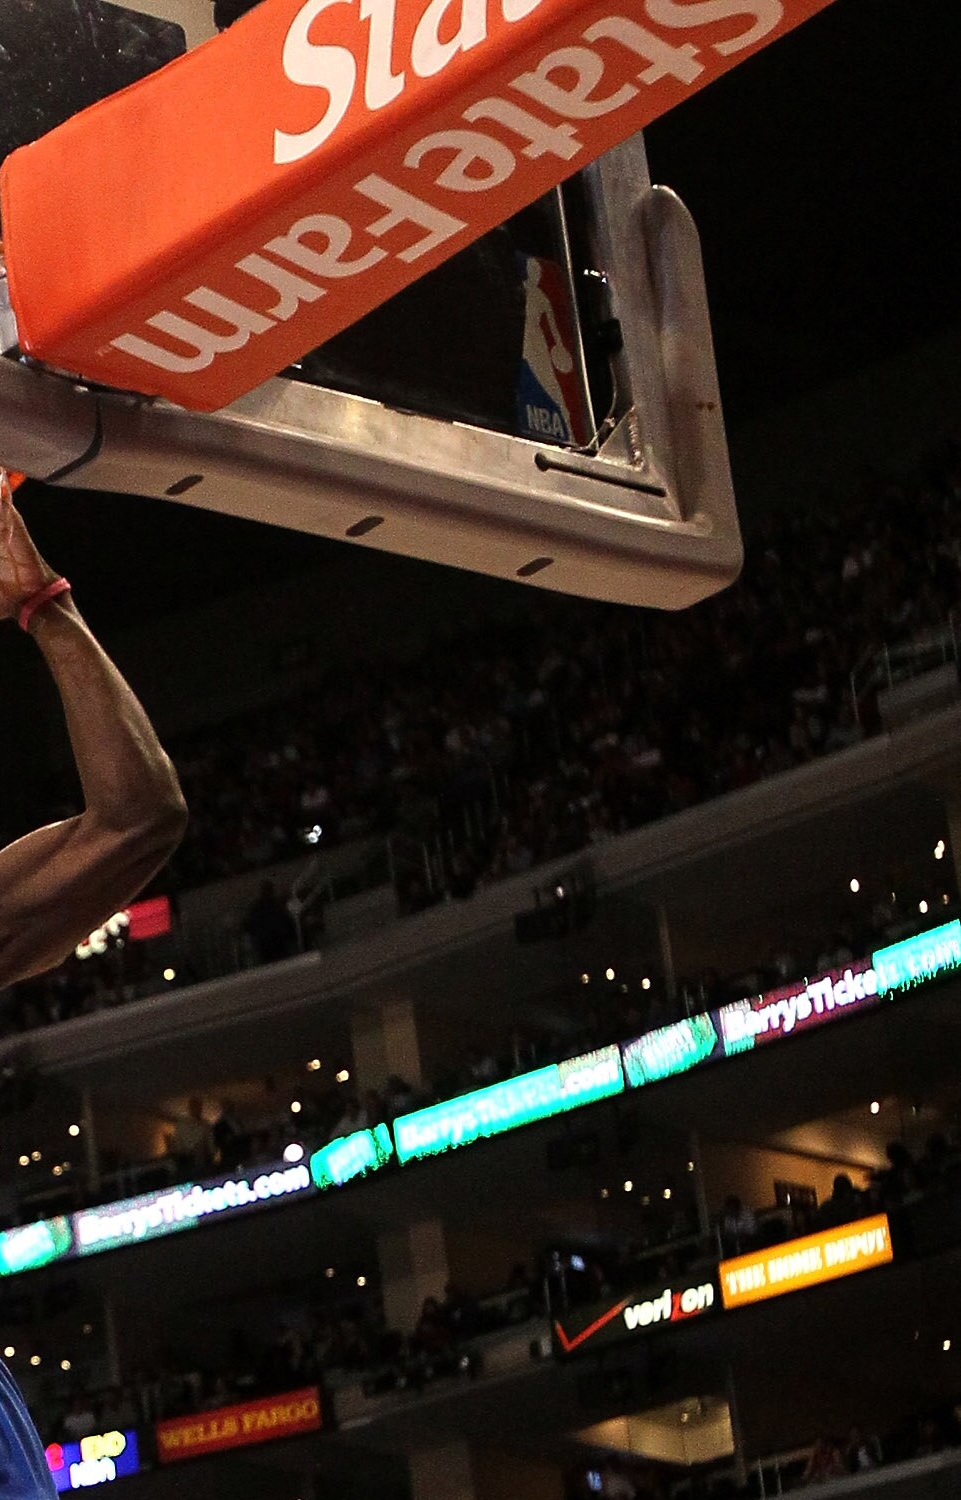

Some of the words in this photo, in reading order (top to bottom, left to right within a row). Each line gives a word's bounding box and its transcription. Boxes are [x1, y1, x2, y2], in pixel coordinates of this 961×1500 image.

[273, 0, 538, 165] Sta
[110, 172, 469, 374] Farm
[526, 404, 564, 440] NBA
[623, 1282, 715, 1331] verizon
[159, 1415, 238, 1449] WELLS
[241, 1400, 319, 1434] FARGO
